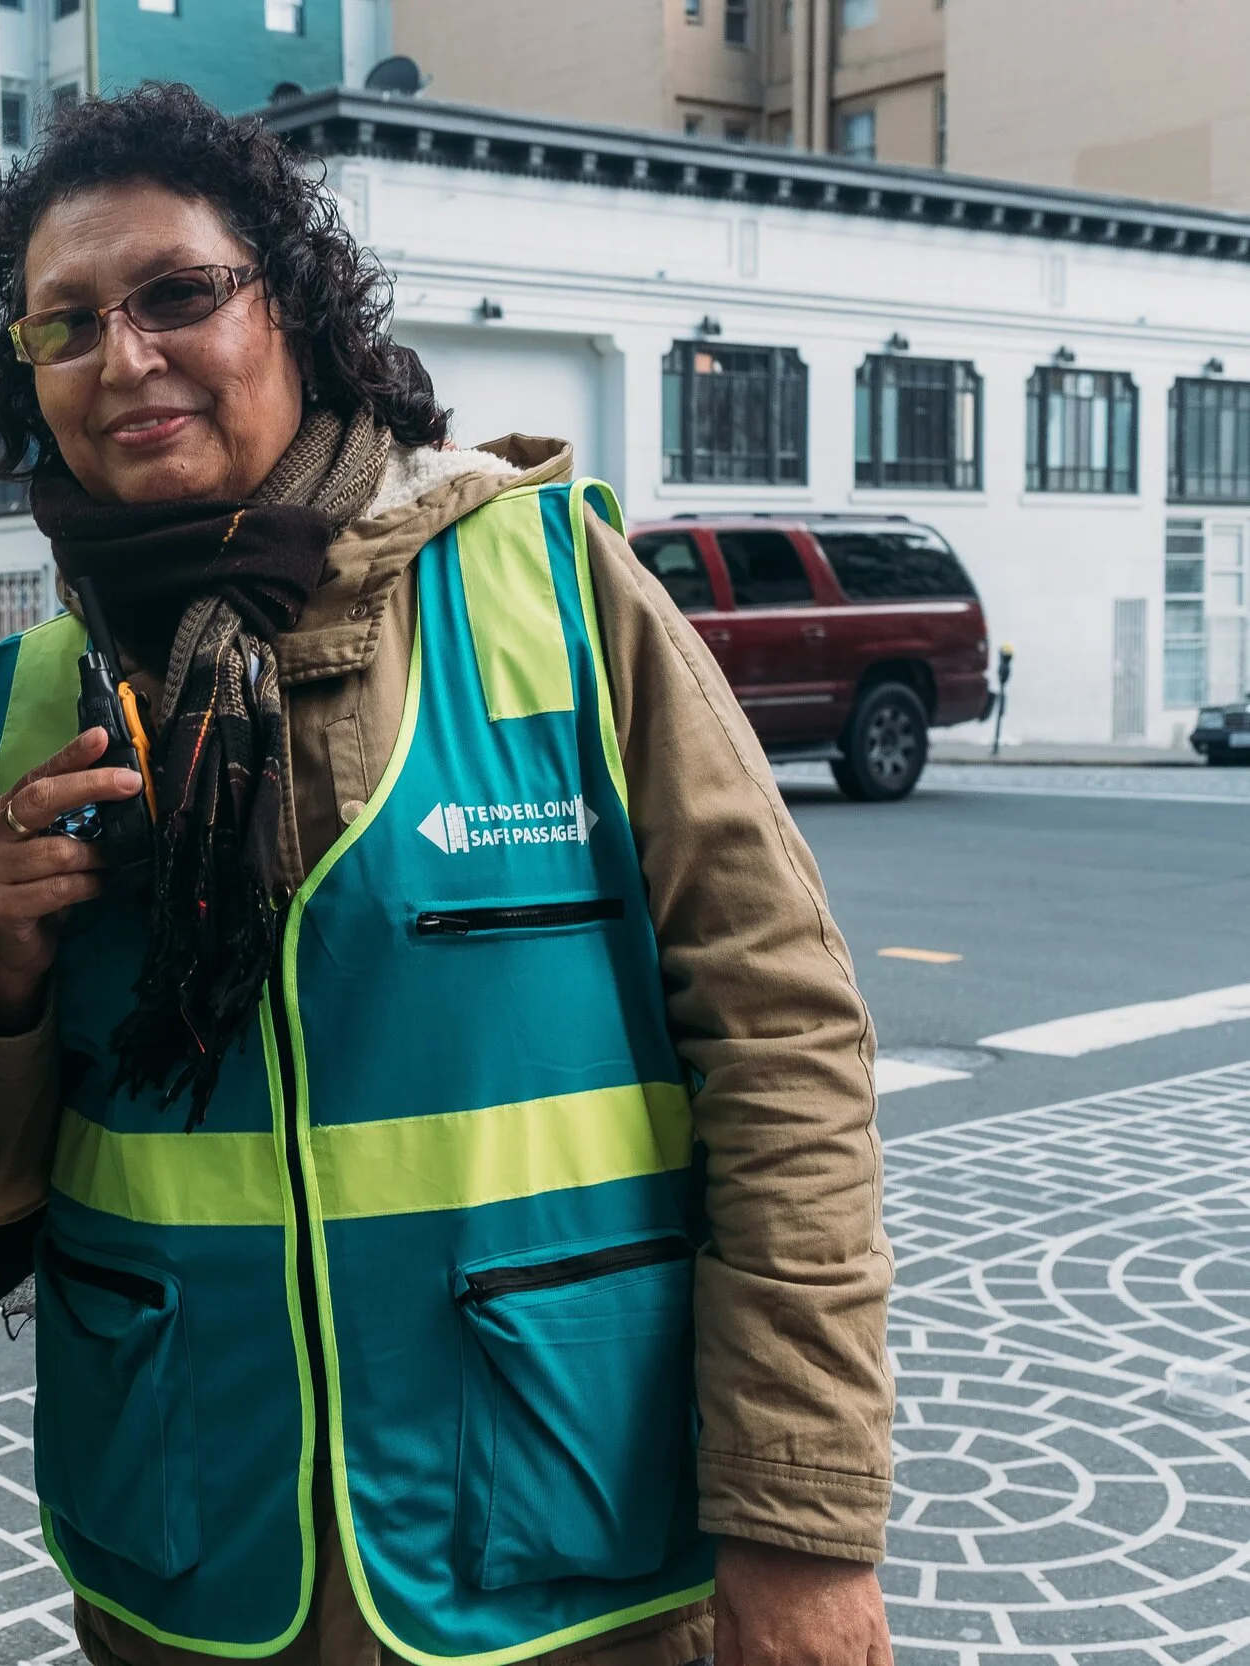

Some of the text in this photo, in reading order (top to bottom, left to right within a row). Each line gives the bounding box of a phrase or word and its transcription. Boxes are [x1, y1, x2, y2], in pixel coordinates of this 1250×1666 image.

[464, 801, 575, 822] TENDERLOIN
[470, 824, 577, 847] SAFE PASSAGE
